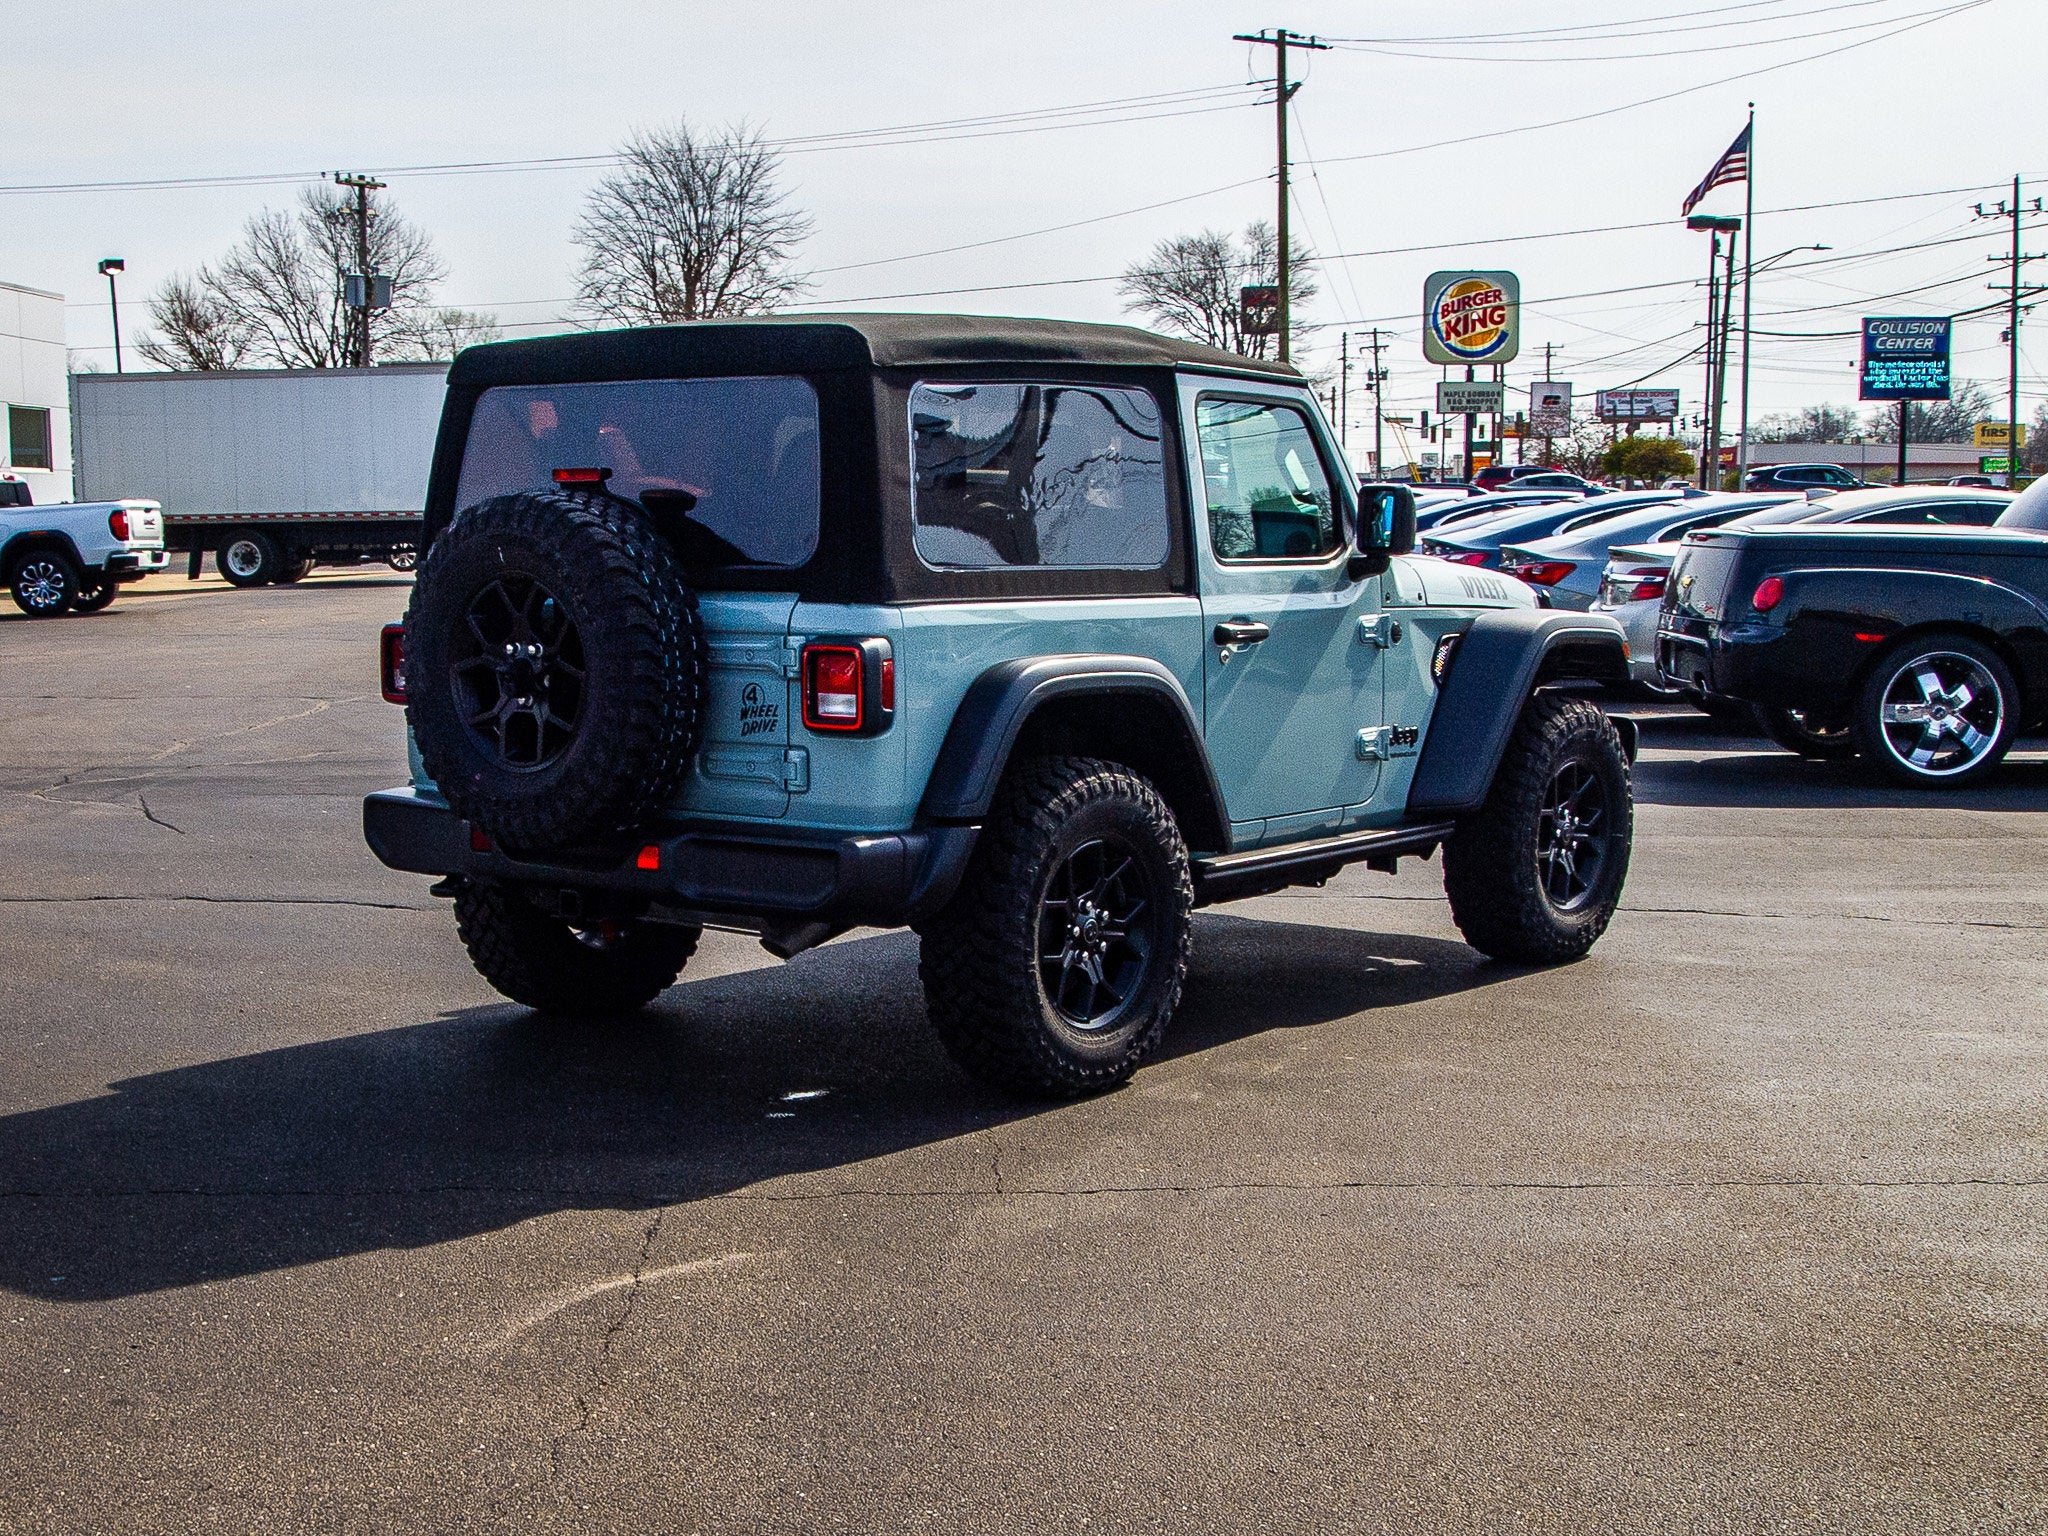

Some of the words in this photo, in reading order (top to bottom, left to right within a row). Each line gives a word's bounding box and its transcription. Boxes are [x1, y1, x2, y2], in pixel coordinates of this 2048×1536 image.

[1441, 289, 1502, 319] BURGER
[1445, 306, 1506, 341] KING
[1869, 322, 1946, 334] COLLISION
[1876, 337, 1934, 349] CENTER
[1457, 576, 1508, 600] WILLYS
[746, 686, 758, 705] 4
[740, 704, 778, 720] WHEEL
[741, 719, 778, 736] DRIVE
[1389, 723, 1418, 748] Jeep
